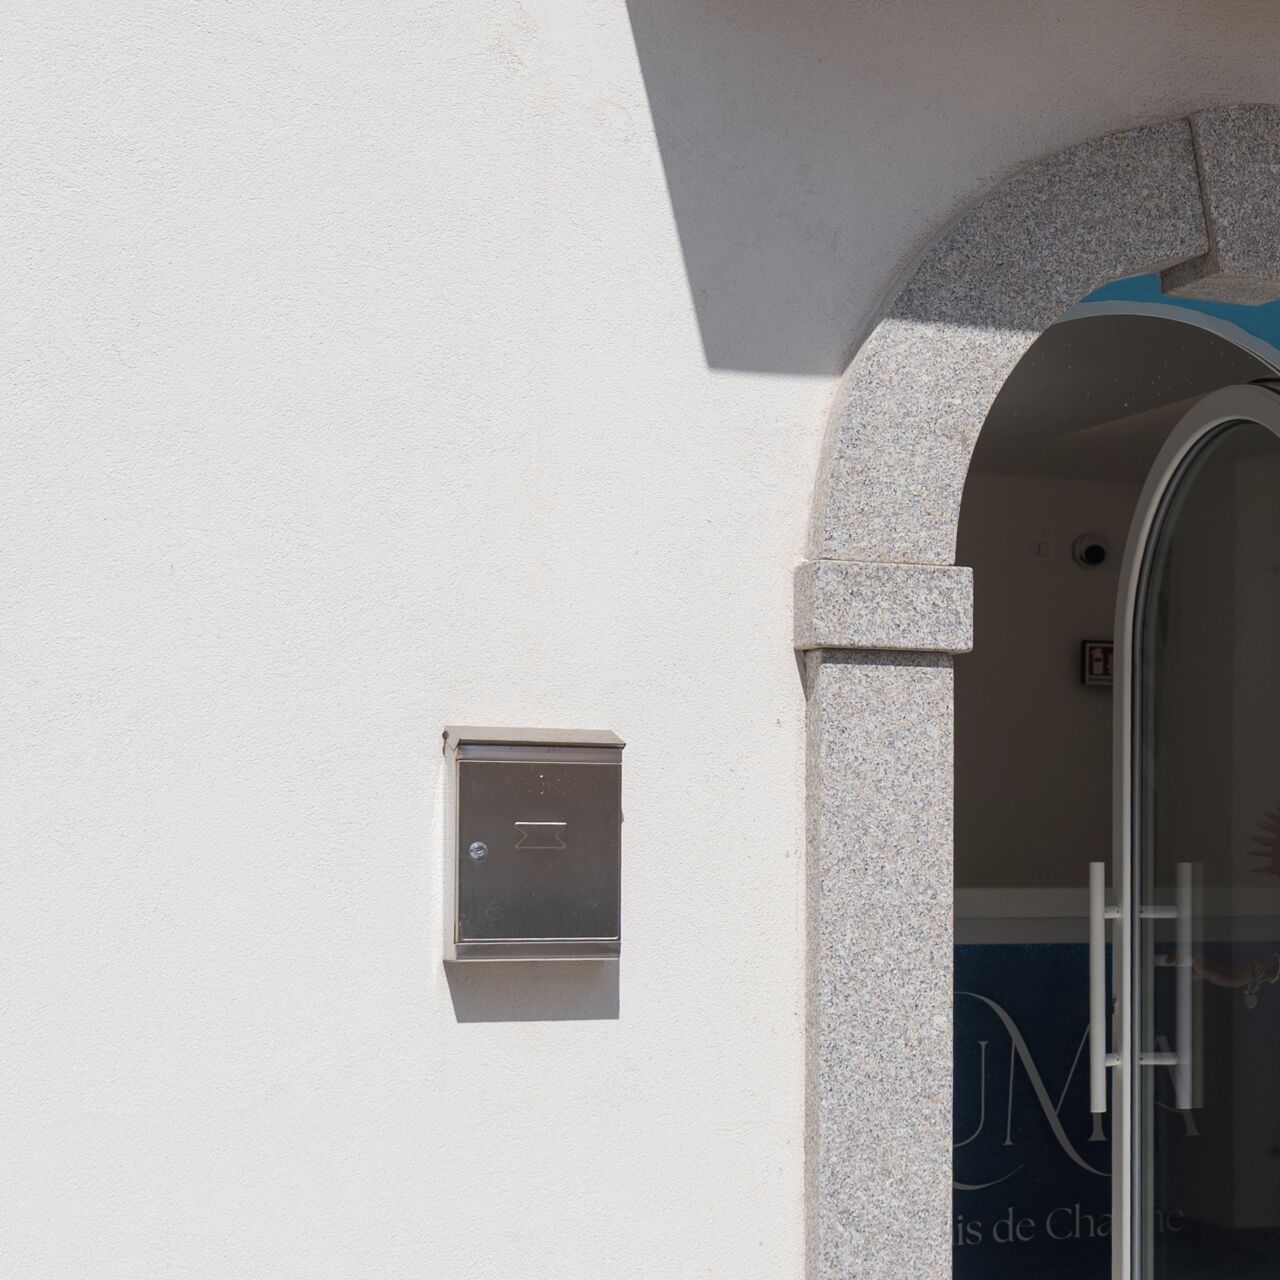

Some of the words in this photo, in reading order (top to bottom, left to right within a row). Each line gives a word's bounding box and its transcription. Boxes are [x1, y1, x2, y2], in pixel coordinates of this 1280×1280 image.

[953, 991, 1200, 1191] MA
[992, 1206, 1036, 1243] de
[1046, 1203, 1186, 1240] Chae
